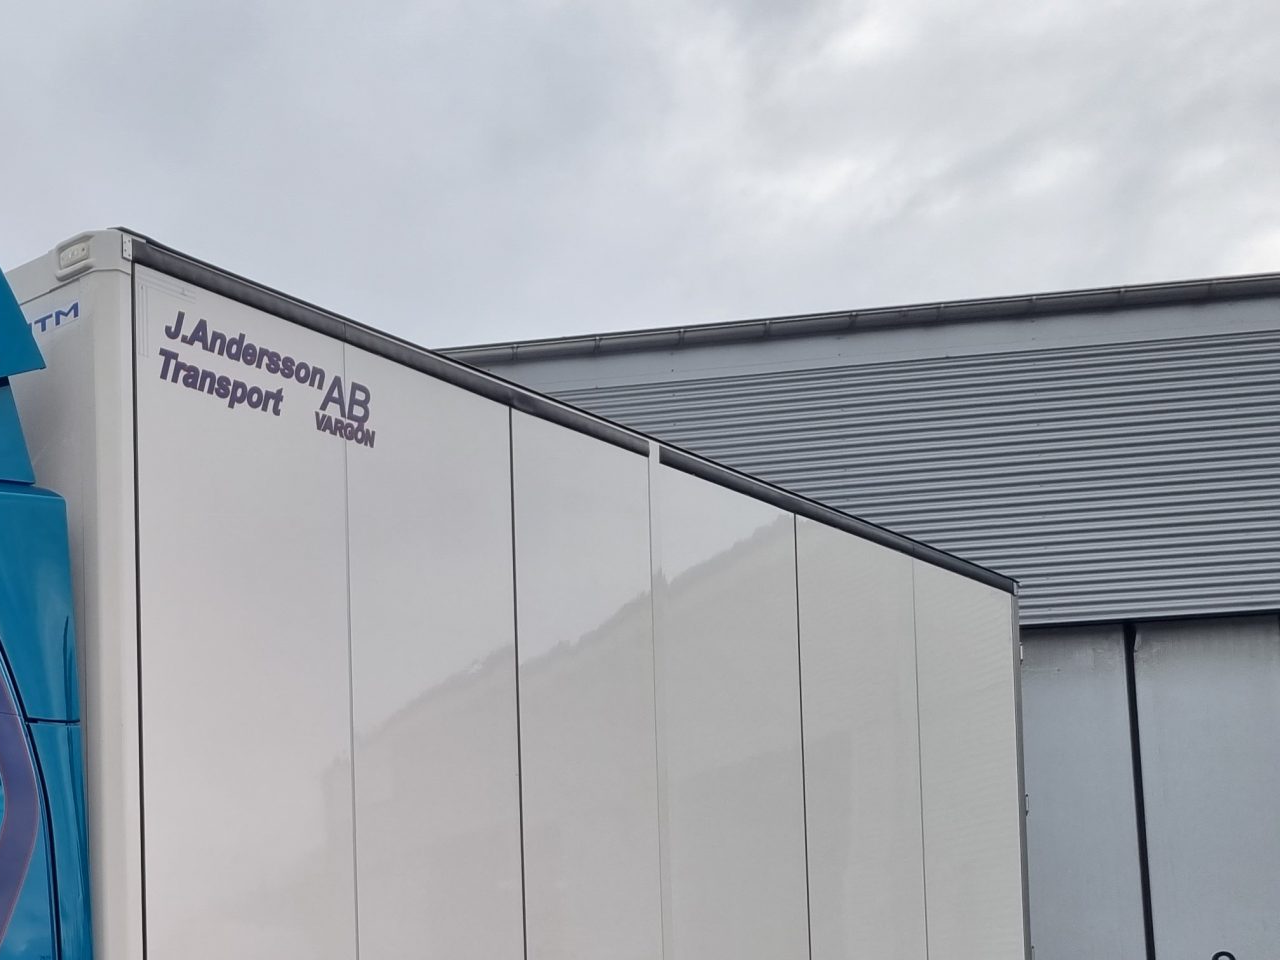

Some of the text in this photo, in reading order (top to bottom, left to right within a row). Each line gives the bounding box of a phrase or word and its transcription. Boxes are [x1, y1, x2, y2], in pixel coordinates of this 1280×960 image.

[28, 301, 79, 332] TM
[159, 347, 284, 416] Transport
[164, 310, 371, 424] J.Andersson AB
